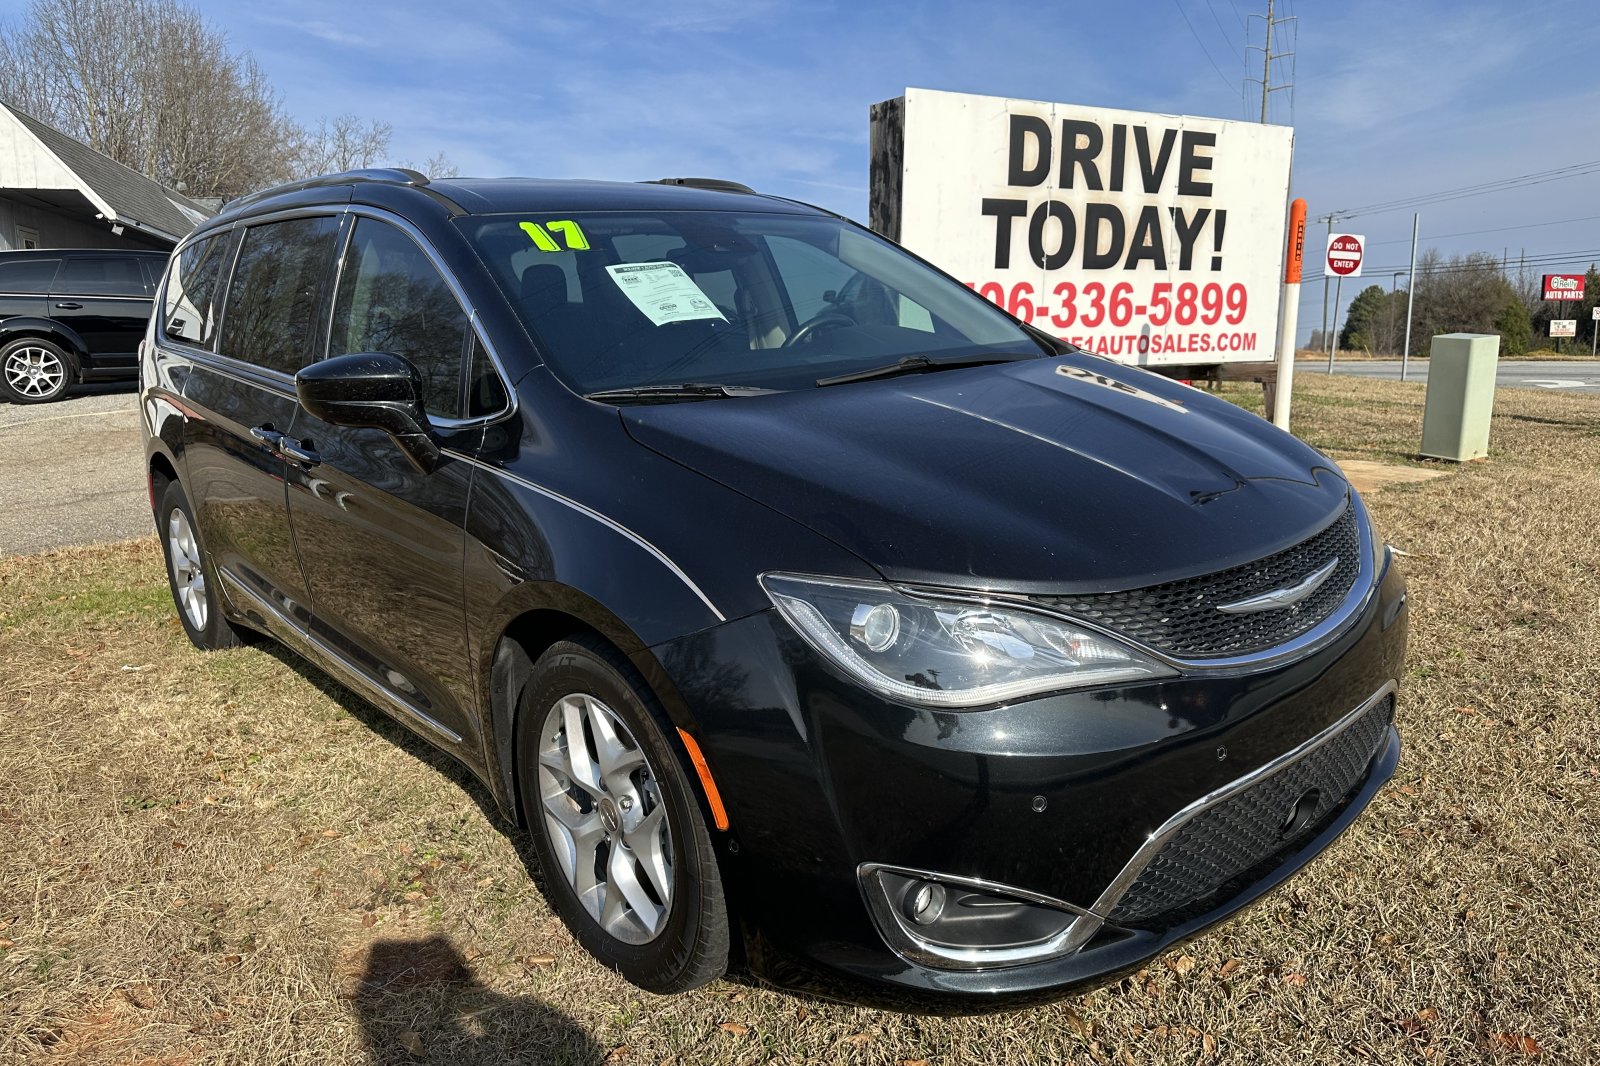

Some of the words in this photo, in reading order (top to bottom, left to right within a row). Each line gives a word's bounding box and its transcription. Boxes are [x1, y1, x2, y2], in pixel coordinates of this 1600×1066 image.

[1008, 114, 1217, 197] DRIVE
[519, 220, 590, 252] 17
[982, 198, 1227, 271] TODAY!
[1334, 260, 1354, 268] ENTER
[964, 281, 1248, 328] 06-336-5899
[1545, 290, 1562, 299] AUTO
[1564, 290, 1584, 299] PARTS
